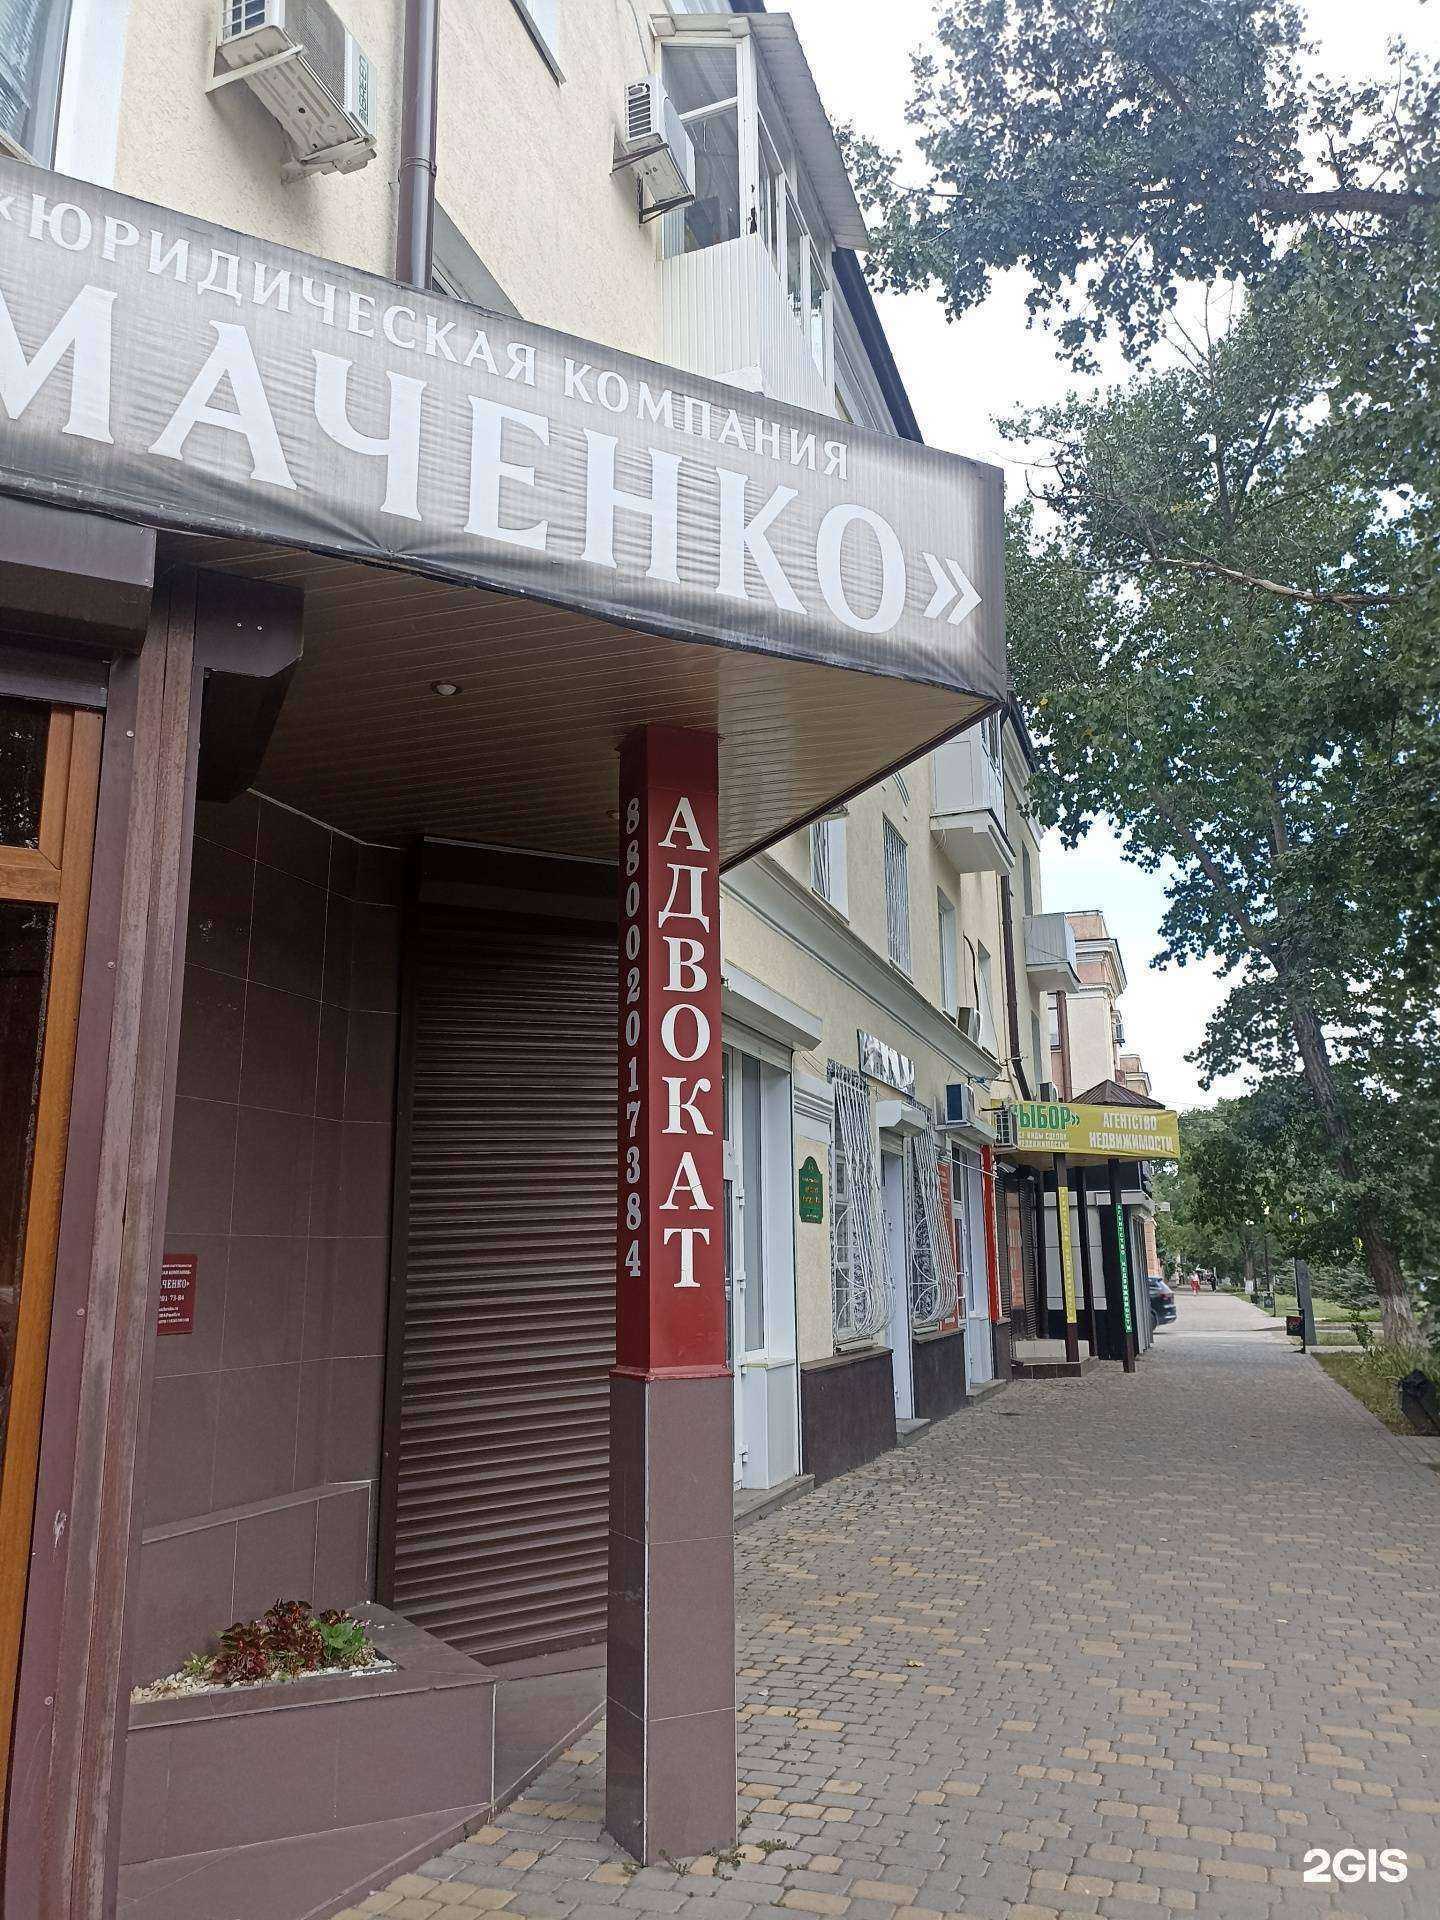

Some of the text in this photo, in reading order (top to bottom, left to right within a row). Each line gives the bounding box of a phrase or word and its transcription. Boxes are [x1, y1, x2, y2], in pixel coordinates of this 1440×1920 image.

[563, 357, 849, 480] КОМПАНИЯ
[657, 797, 715, 1288] АДВОКАТ
[1010, 1103, 1080, 1130] ЫБОР»
[1103, 1112, 1157, 1131] АГЕНТСТВО
[1088, 1131, 1174, 1152] НЕДВИЖИМОСТИ
[160, 1279, 190, 1289] ЧЕНКО»
